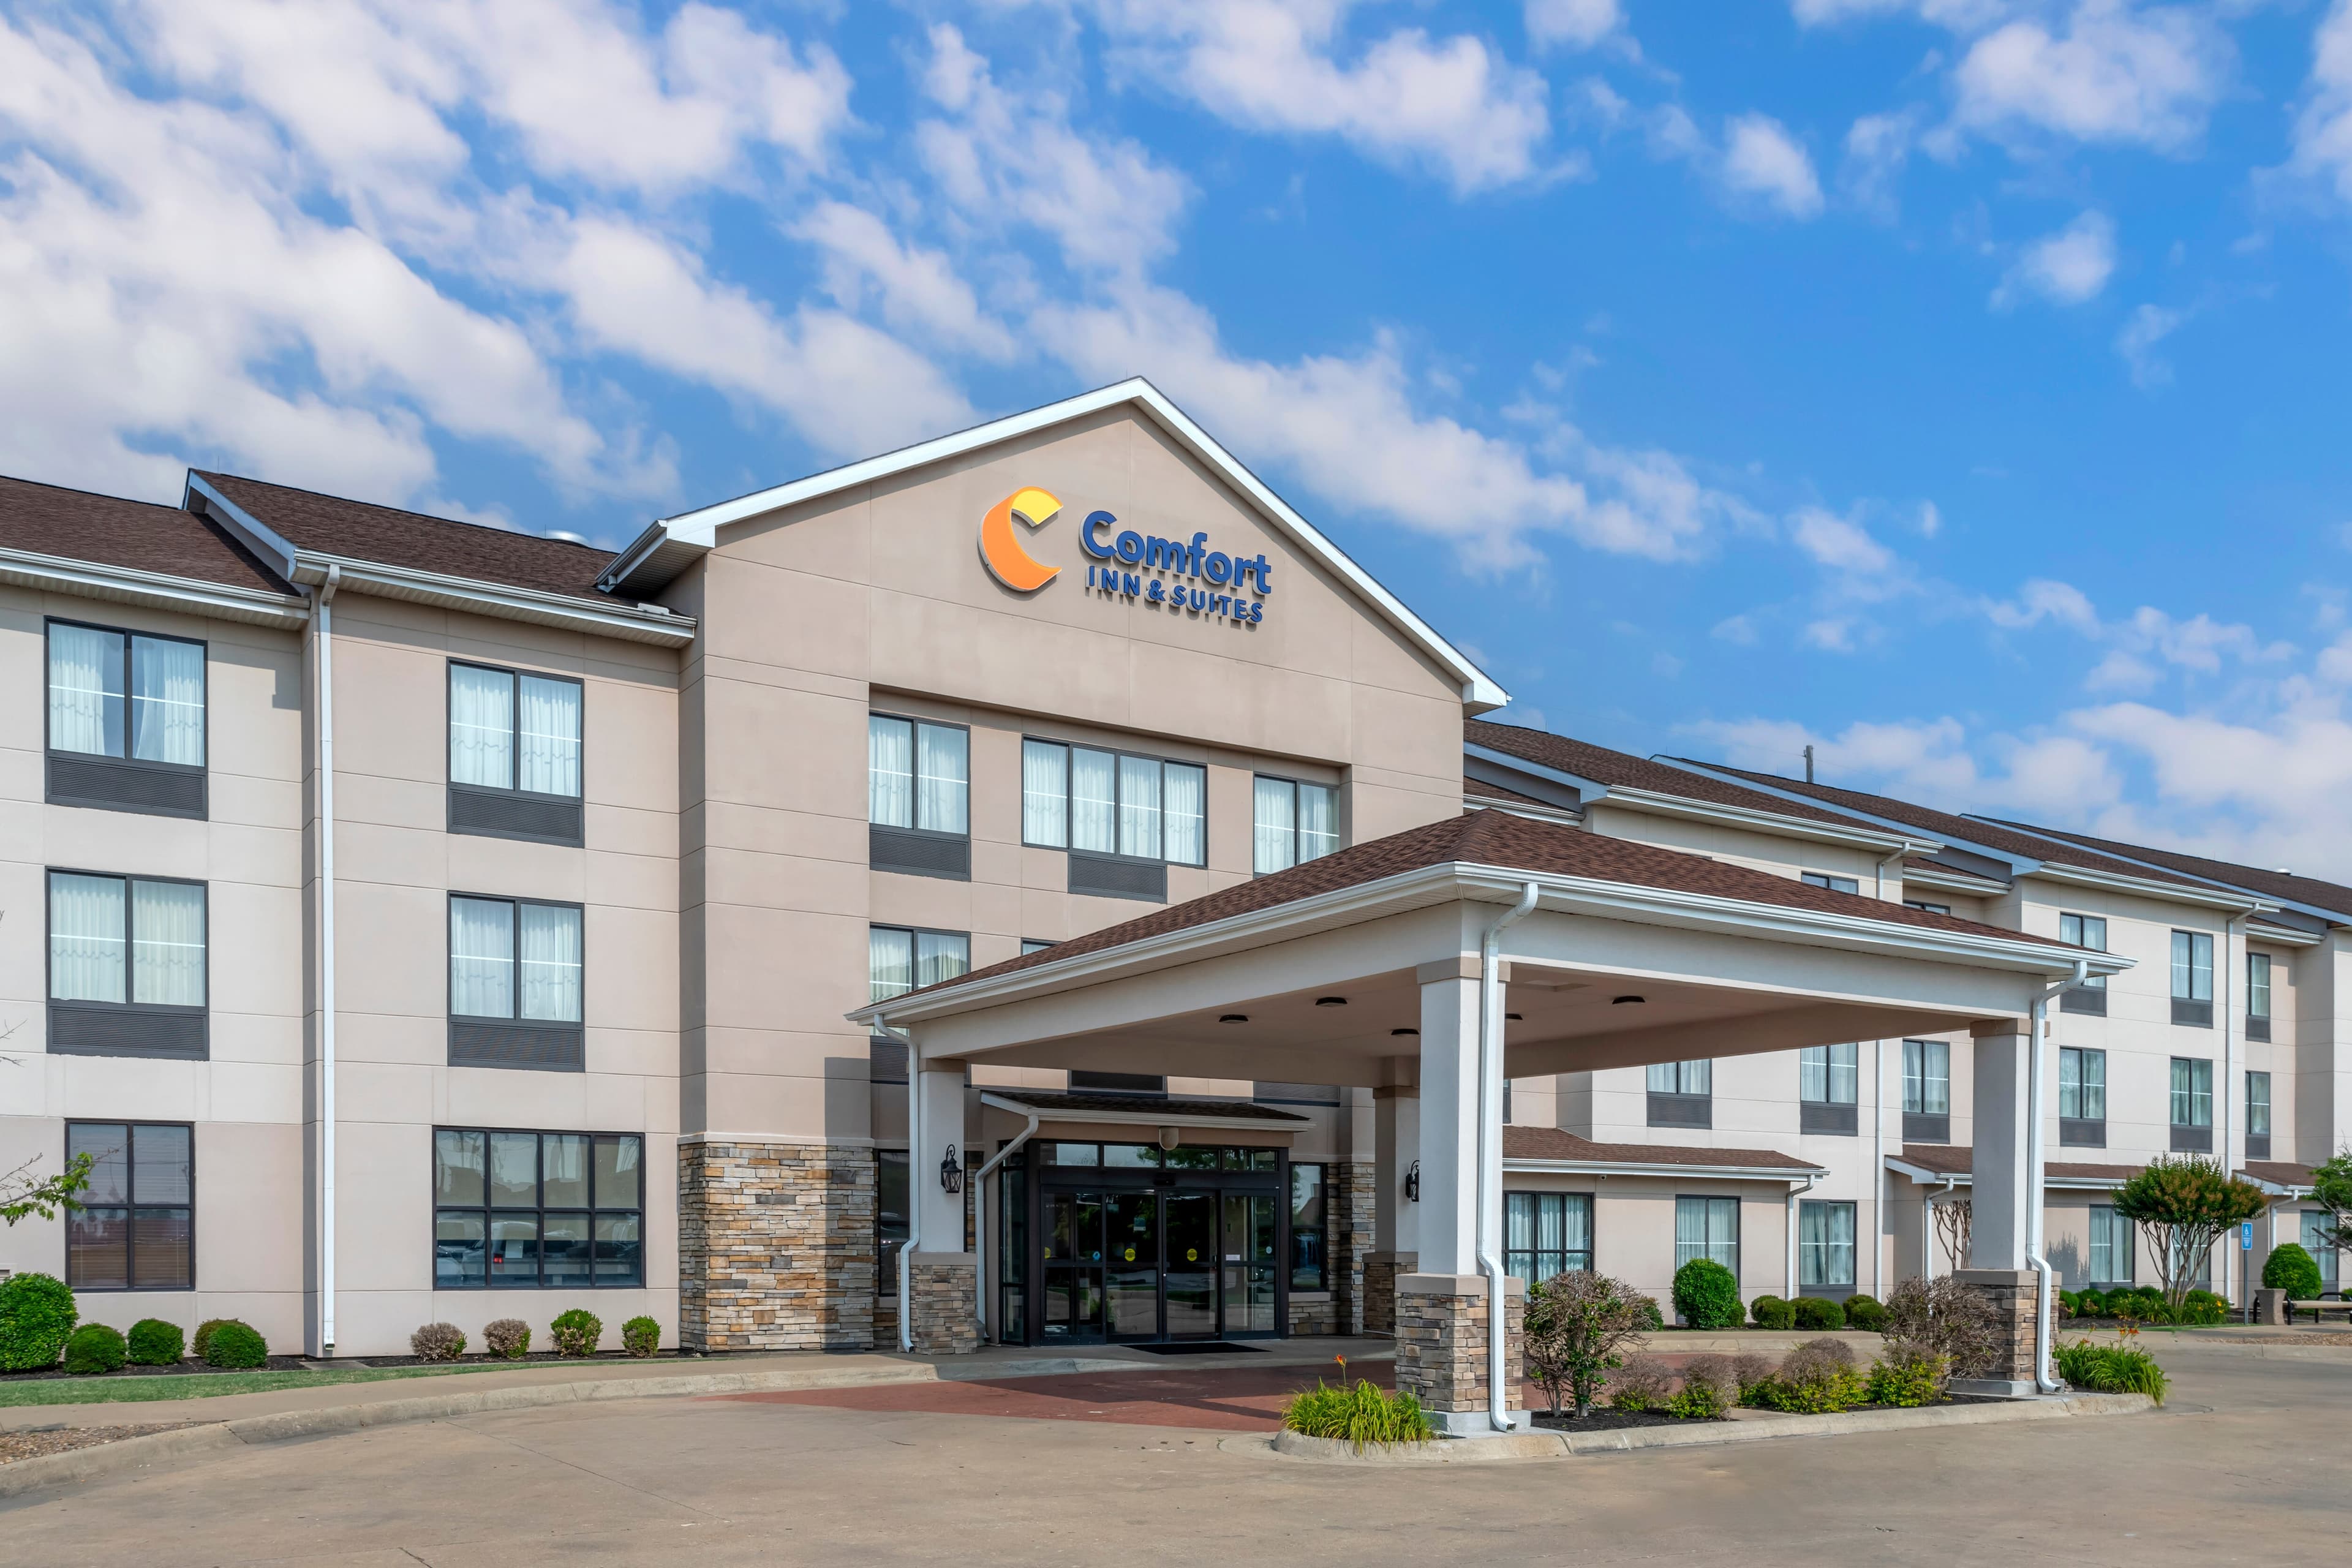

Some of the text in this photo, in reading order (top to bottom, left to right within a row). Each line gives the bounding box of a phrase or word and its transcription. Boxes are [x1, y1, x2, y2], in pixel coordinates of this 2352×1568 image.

[1080, 510, 1272, 595] Comfort
[1087, 565, 1264, 624] INN & SUITES
